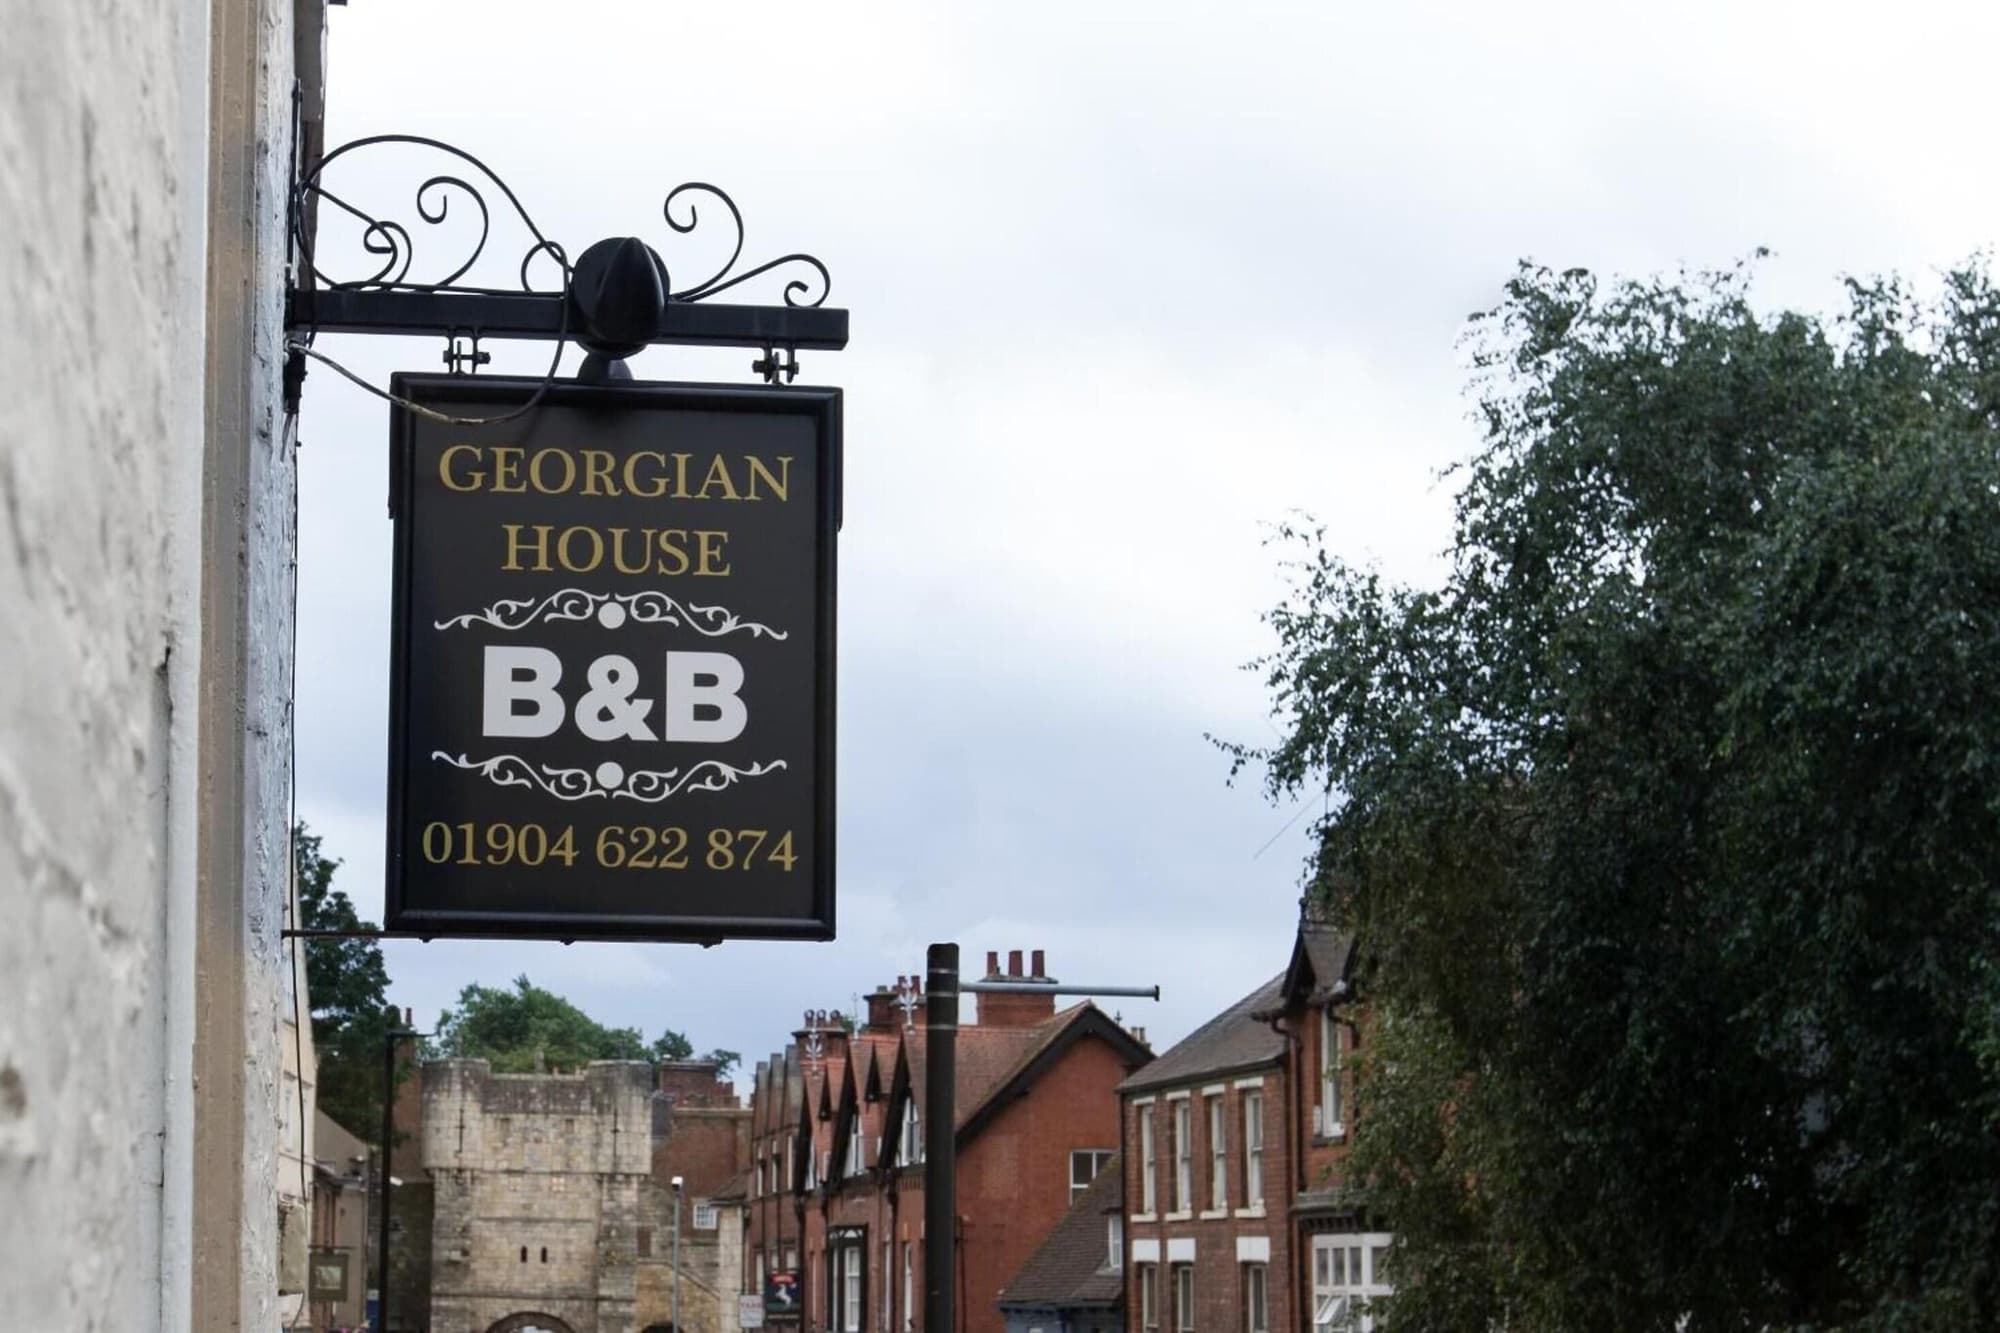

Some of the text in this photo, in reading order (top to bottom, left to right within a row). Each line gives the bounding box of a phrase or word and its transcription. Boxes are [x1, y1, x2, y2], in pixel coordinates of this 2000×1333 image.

[439, 444, 794, 502] GEORGIAN
[501, 524, 731, 577] HOUSE
[482, 644, 749, 744] B&B
[422, 821, 798, 872] 01904 622 874
